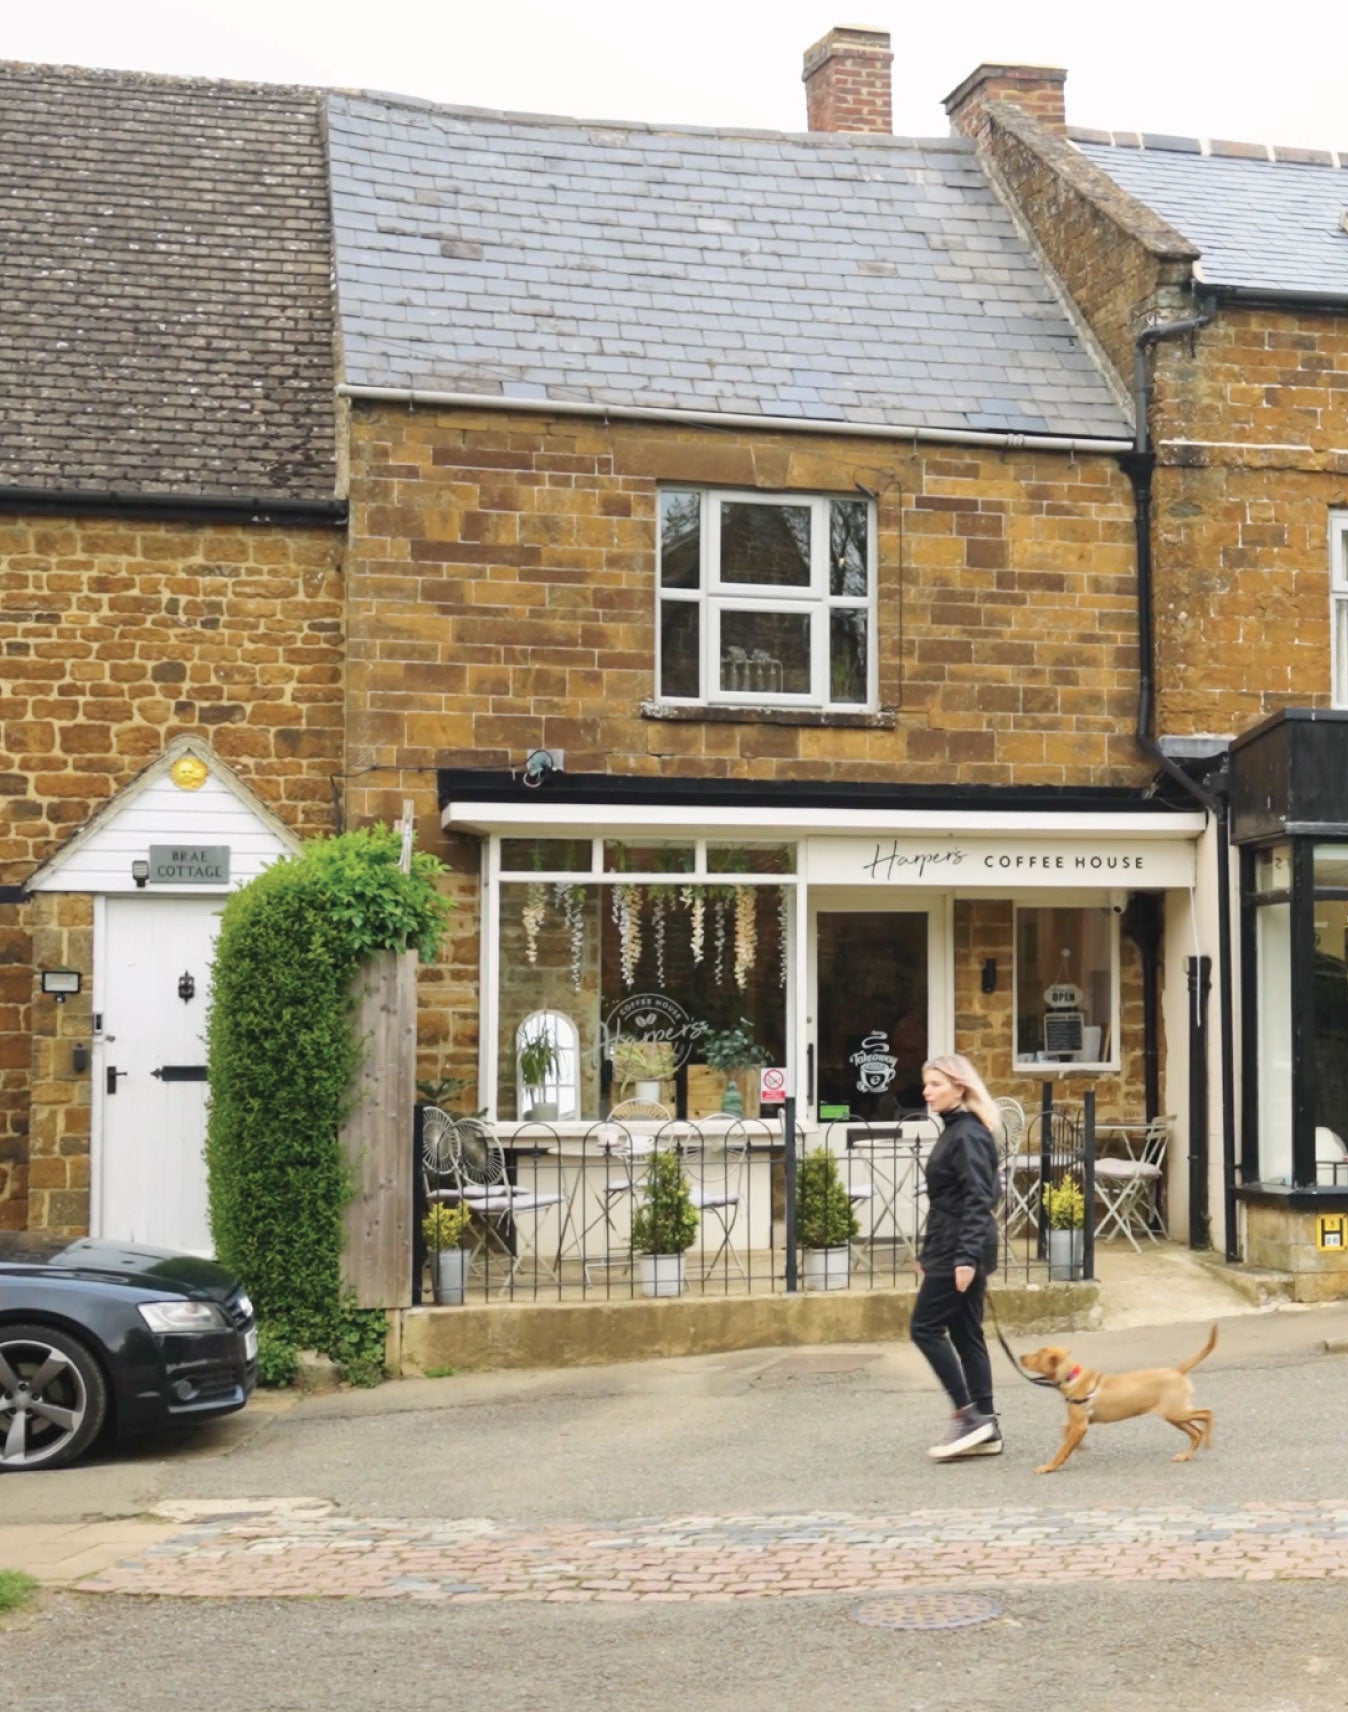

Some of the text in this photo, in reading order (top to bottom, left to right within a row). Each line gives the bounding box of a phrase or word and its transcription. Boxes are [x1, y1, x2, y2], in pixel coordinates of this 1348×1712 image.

[172, 851, 207, 861] BRAE
[862, 839, 1144, 881] Harper's COFFEE HOUSE
[157, 865, 222, 878] COTTAGE
[1052, 992, 1075, 1002] OPEN
[619, 998, 683, 1020] COFFEE HOUSE
